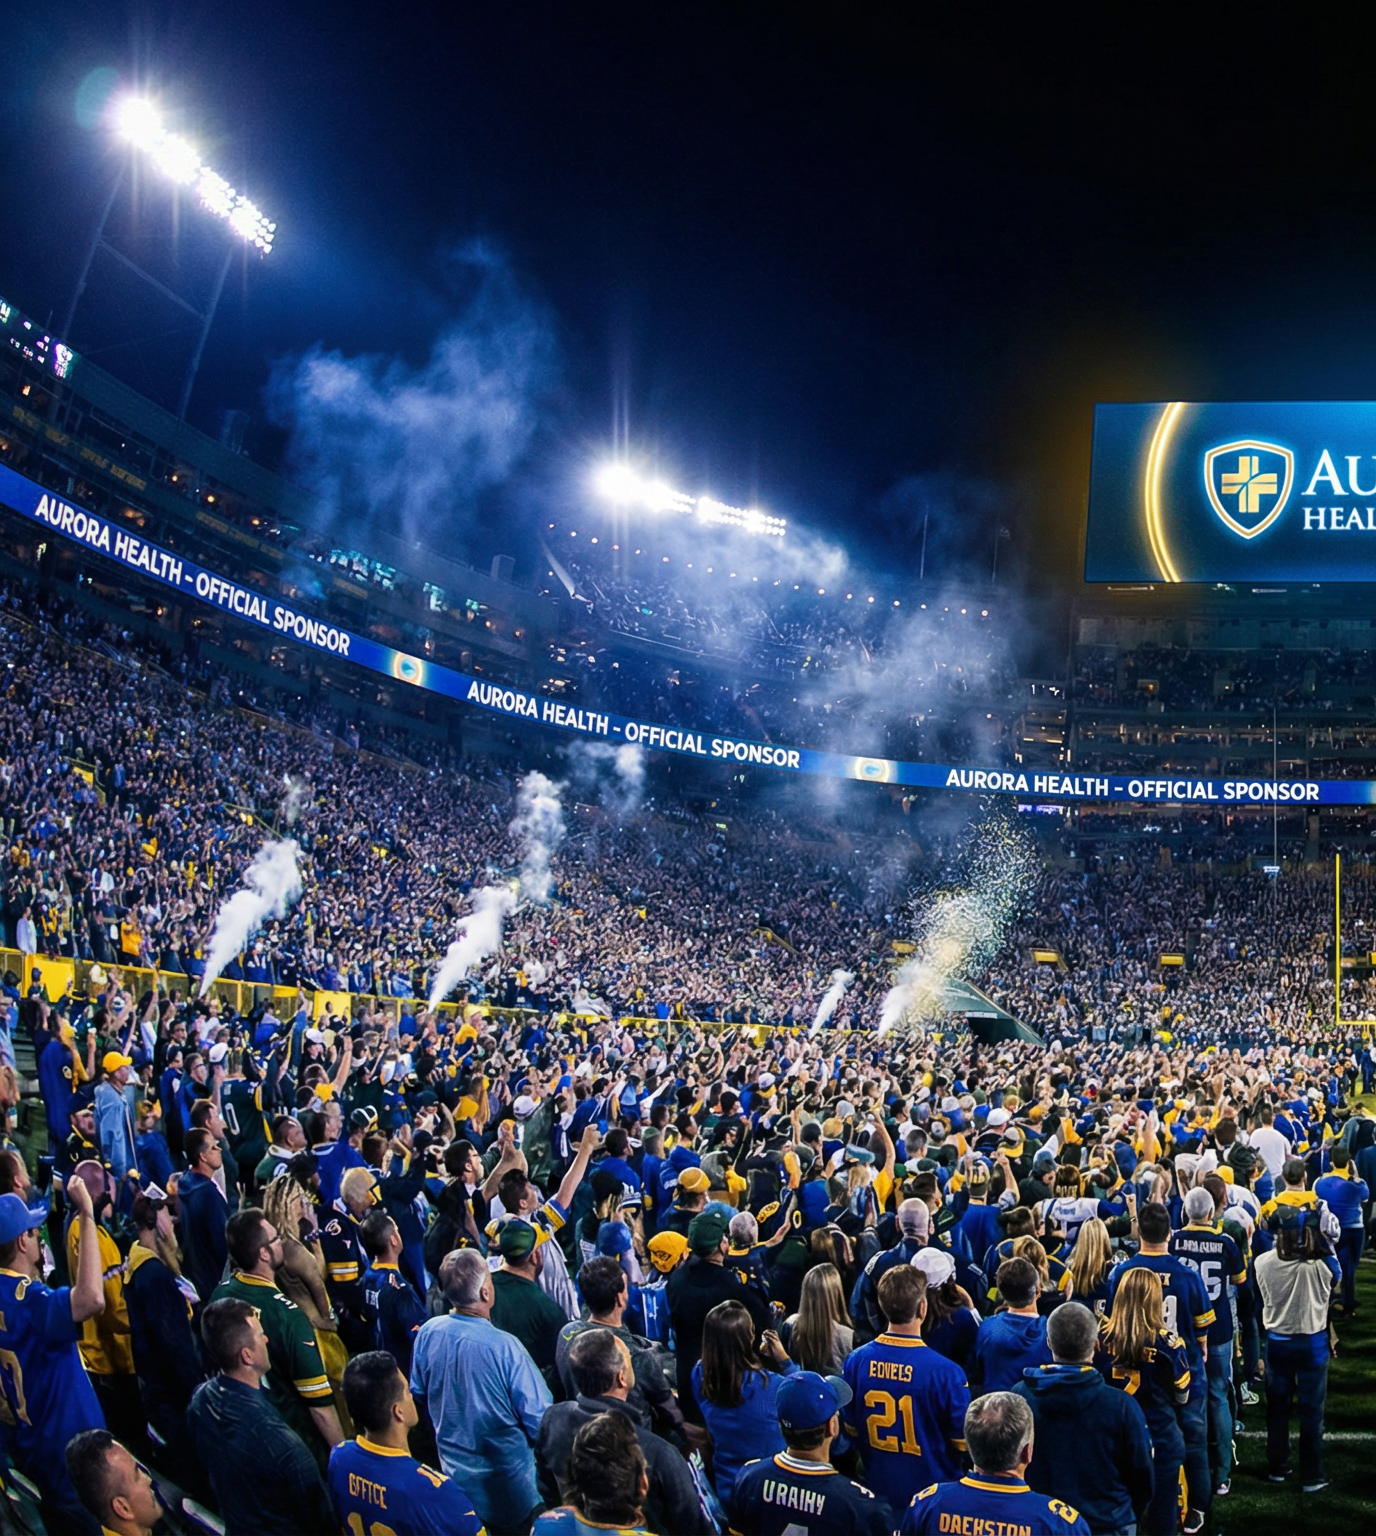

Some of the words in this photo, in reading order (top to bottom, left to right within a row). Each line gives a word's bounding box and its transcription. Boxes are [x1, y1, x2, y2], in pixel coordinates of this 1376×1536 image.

[34, 494, 110, 552] AURORA
[114, 531, 183, 585] HEALTH
[195, 572, 270, 625] OFFICIAL
[273, 606, 350, 656] SPONSOR
[467, 680, 539, 719] AURORA
[542, 701, 609, 736] HEALTH
[624, 722, 707, 755] OFFICIAL
[710, 738, 800, 769] SPONSOR
[945, 768, 1029, 792] AURORA
[1034, 775, 1109, 796] HEALTH
[1127, 779, 1219, 800] OFFICIAL
[1223, 781, 1320, 801] SPONSOR
[864, 1389, 922, 1457] 21
